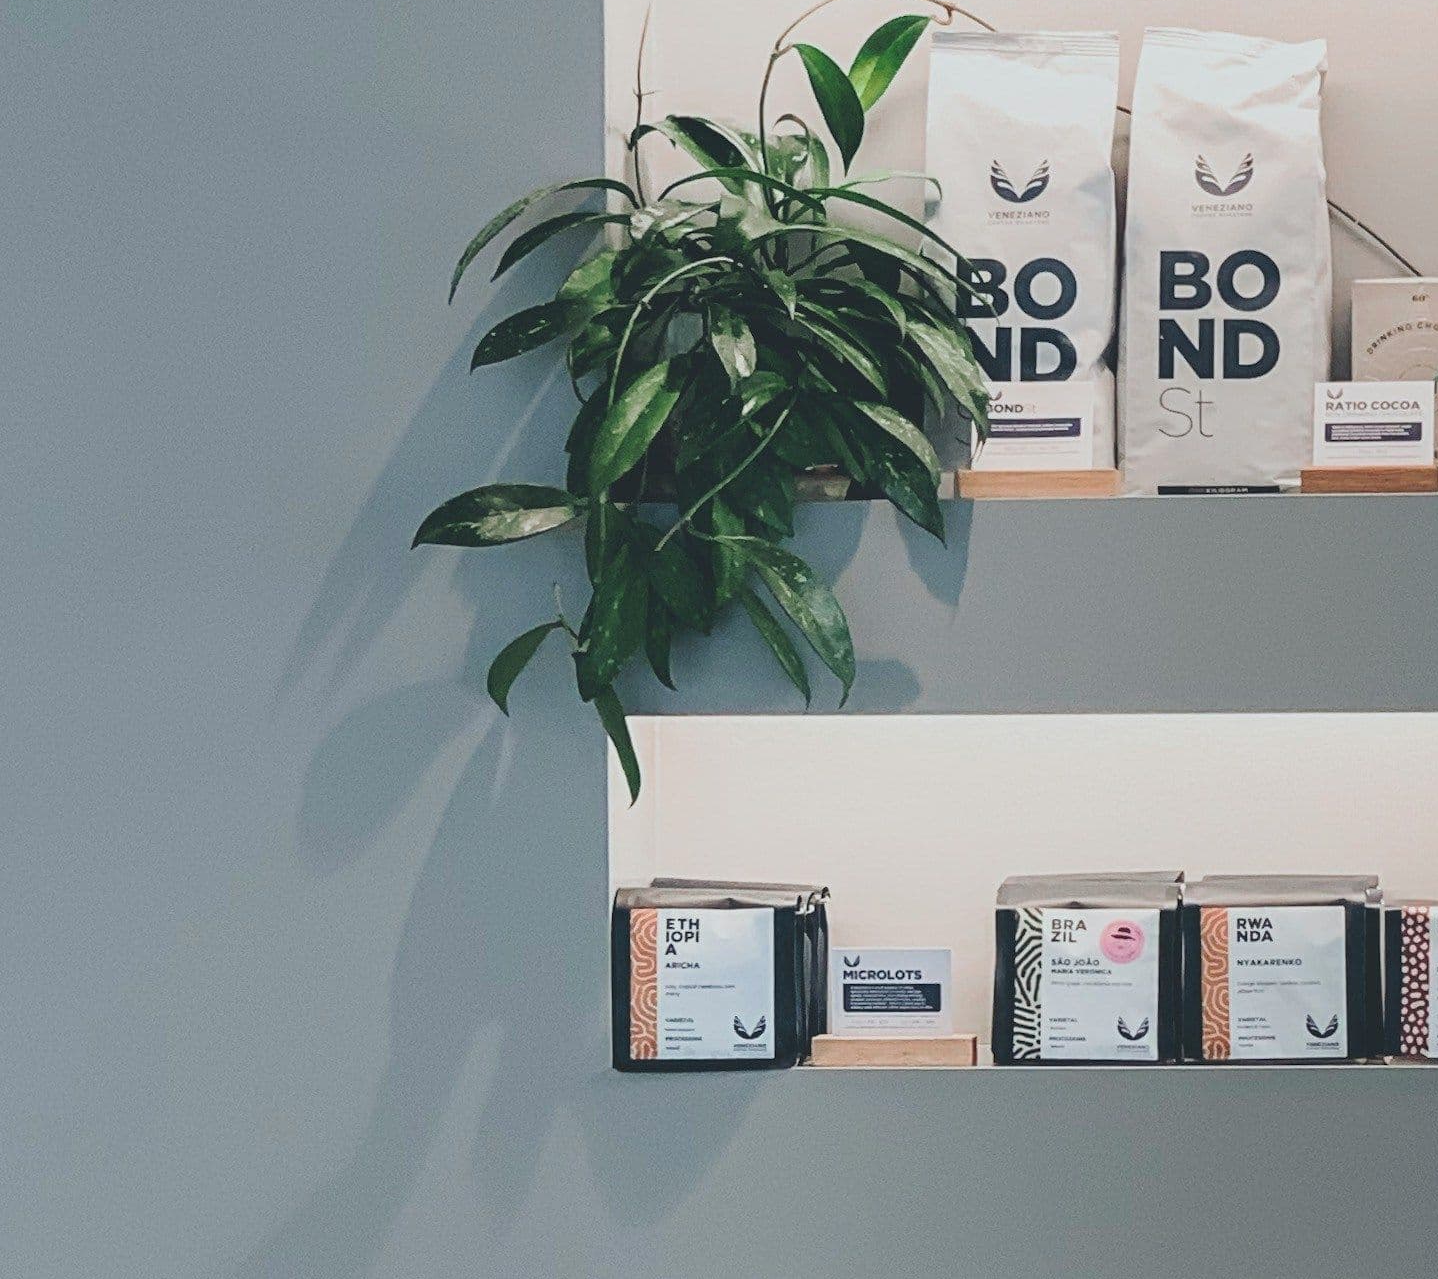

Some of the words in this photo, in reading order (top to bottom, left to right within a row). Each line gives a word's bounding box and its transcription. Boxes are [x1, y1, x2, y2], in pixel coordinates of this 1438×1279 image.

[1192, 203, 1253, 212] VENEZIANO
[988, 211, 1050, 219] VENEZIANO
[1160, 249, 1281, 312] BO
[957, 258, 1077, 320] BO
[1158, 319, 1280, 379] ND
[1326, 401, 1367, 410] RATIO
[1371, 401, 1420, 410] COCOA
[1159, 387, 1213, 438] St
[666, 919, 700, 930] ETH
[1052, 919, 1087, 931] BRA
[1237, 918, 1273, 929] RWA
[666, 931, 699, 942] IOPI
[1051, 931, 1077, 943] ZIL
[1237, 931, 1273, 942] NDA
[665, 944, 677, 955] A
[843, 971, 922, 980] MICROLOTS
